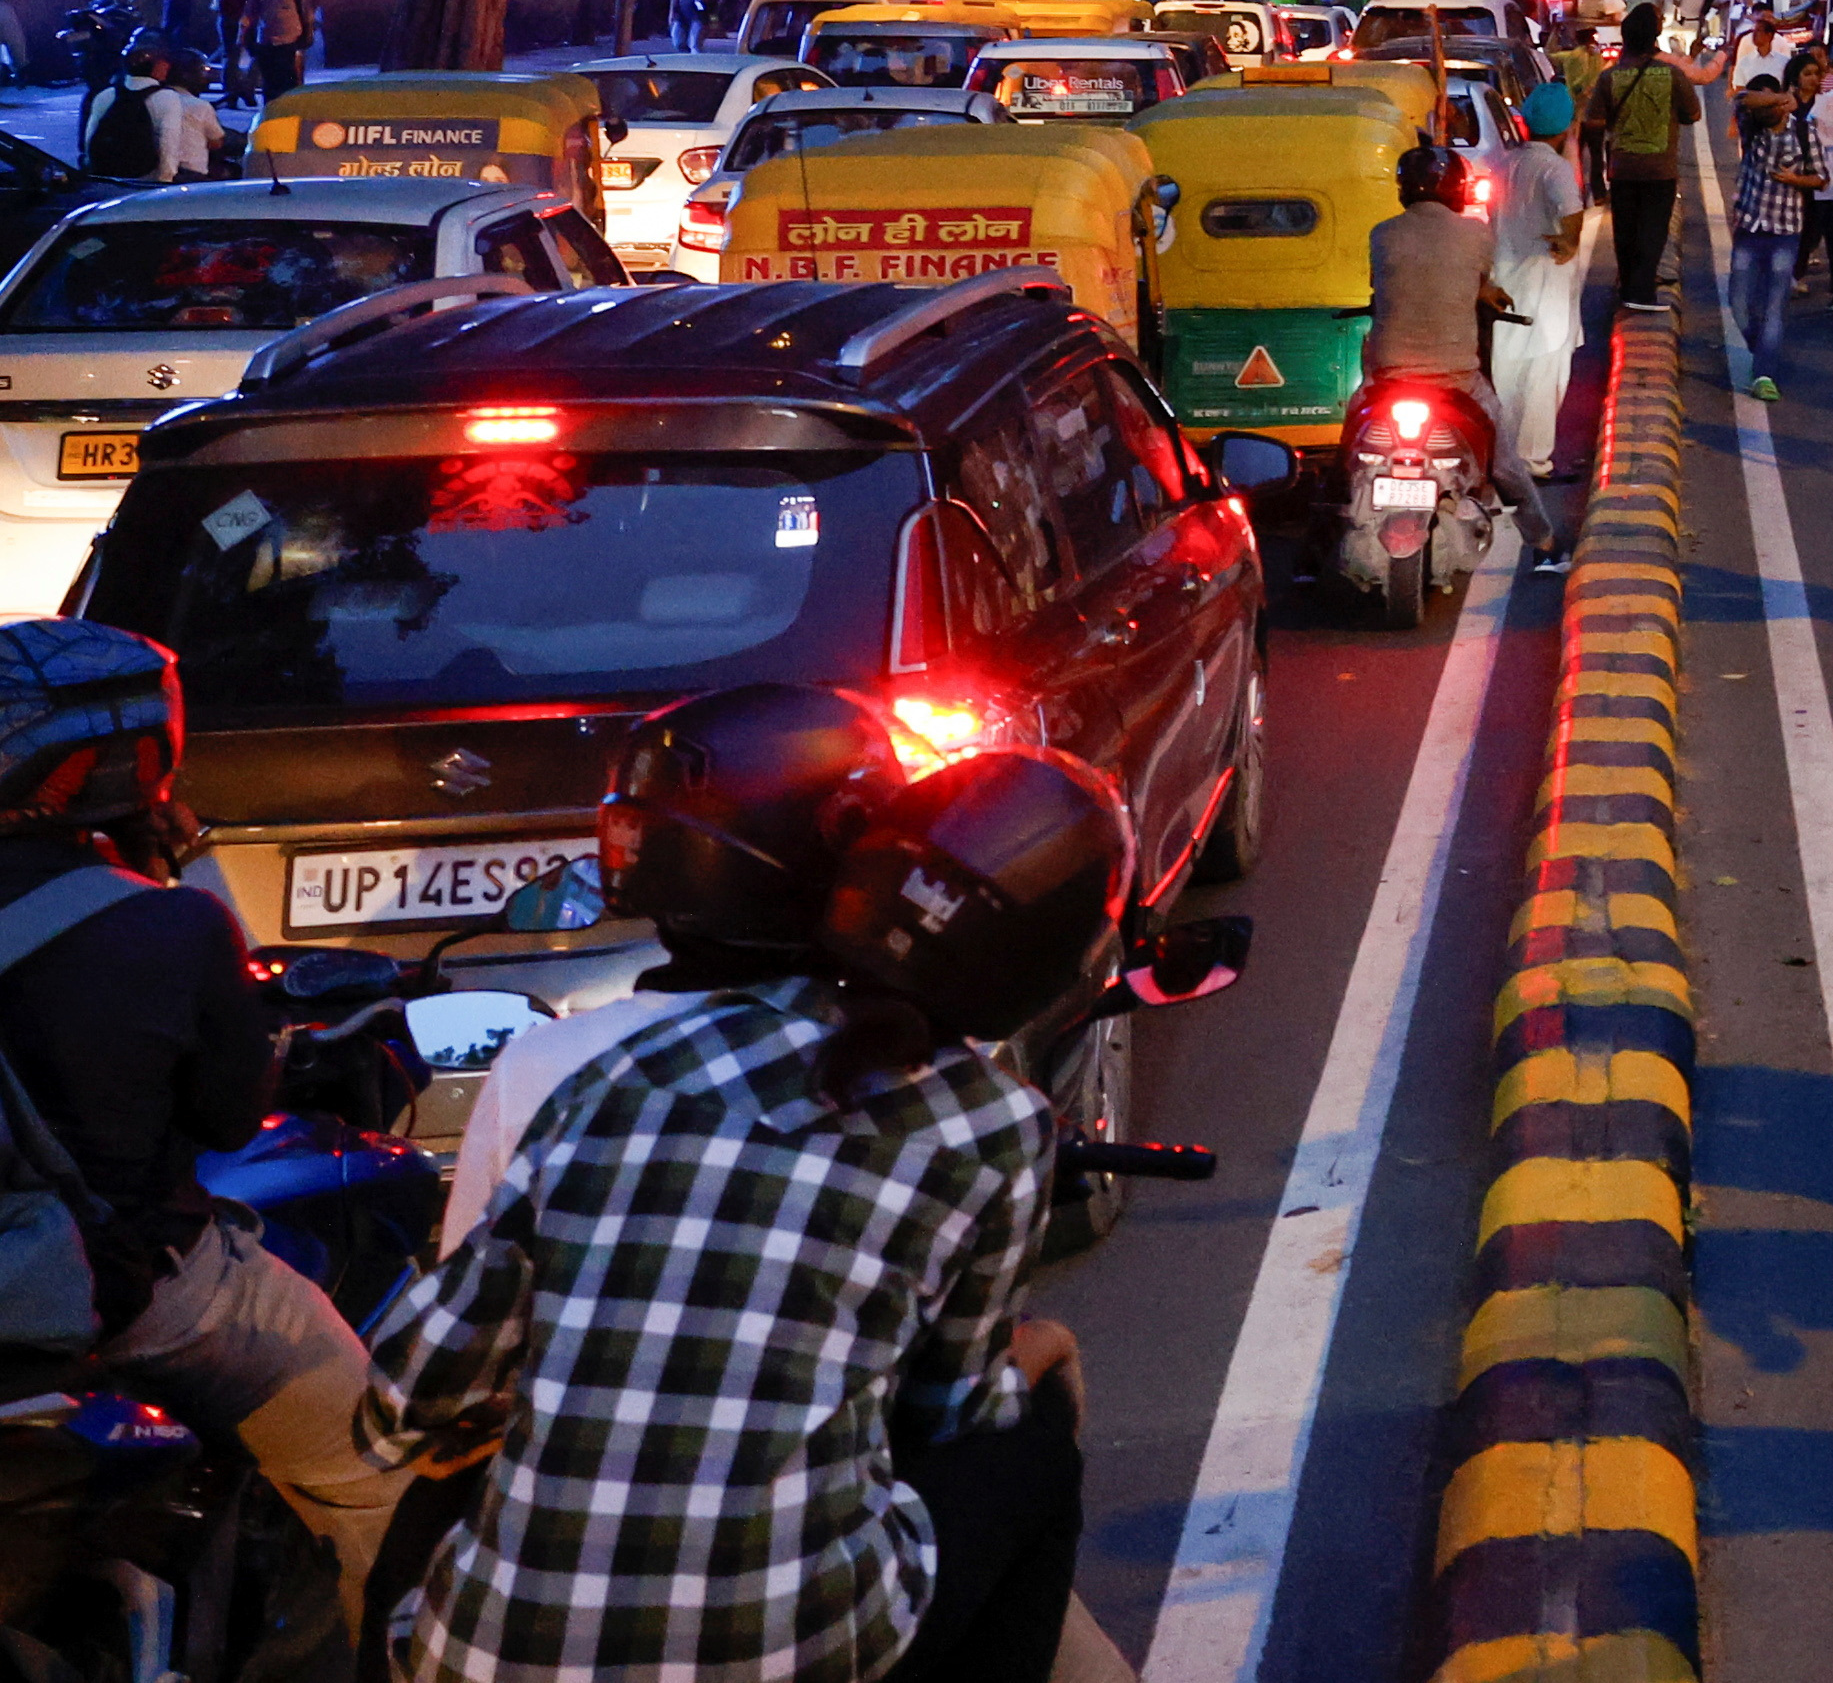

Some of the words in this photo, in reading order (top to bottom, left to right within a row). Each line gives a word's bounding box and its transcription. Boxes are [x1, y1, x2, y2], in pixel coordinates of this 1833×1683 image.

[1068, 75, 1124, 91] Rentals
[346, 125, 398, 145] IIFL
[401, 129, 483, 144] FINANCE
[408, 154, 463, 178] लोन
[788, 217, 873, 245] लोन
[883, 214, 928, 245] ही
[938, 215, 1023, 242] लोन
[880, 251, 1060, 280] FINANCE
[322, 854, 569, 914] UP14ES9
